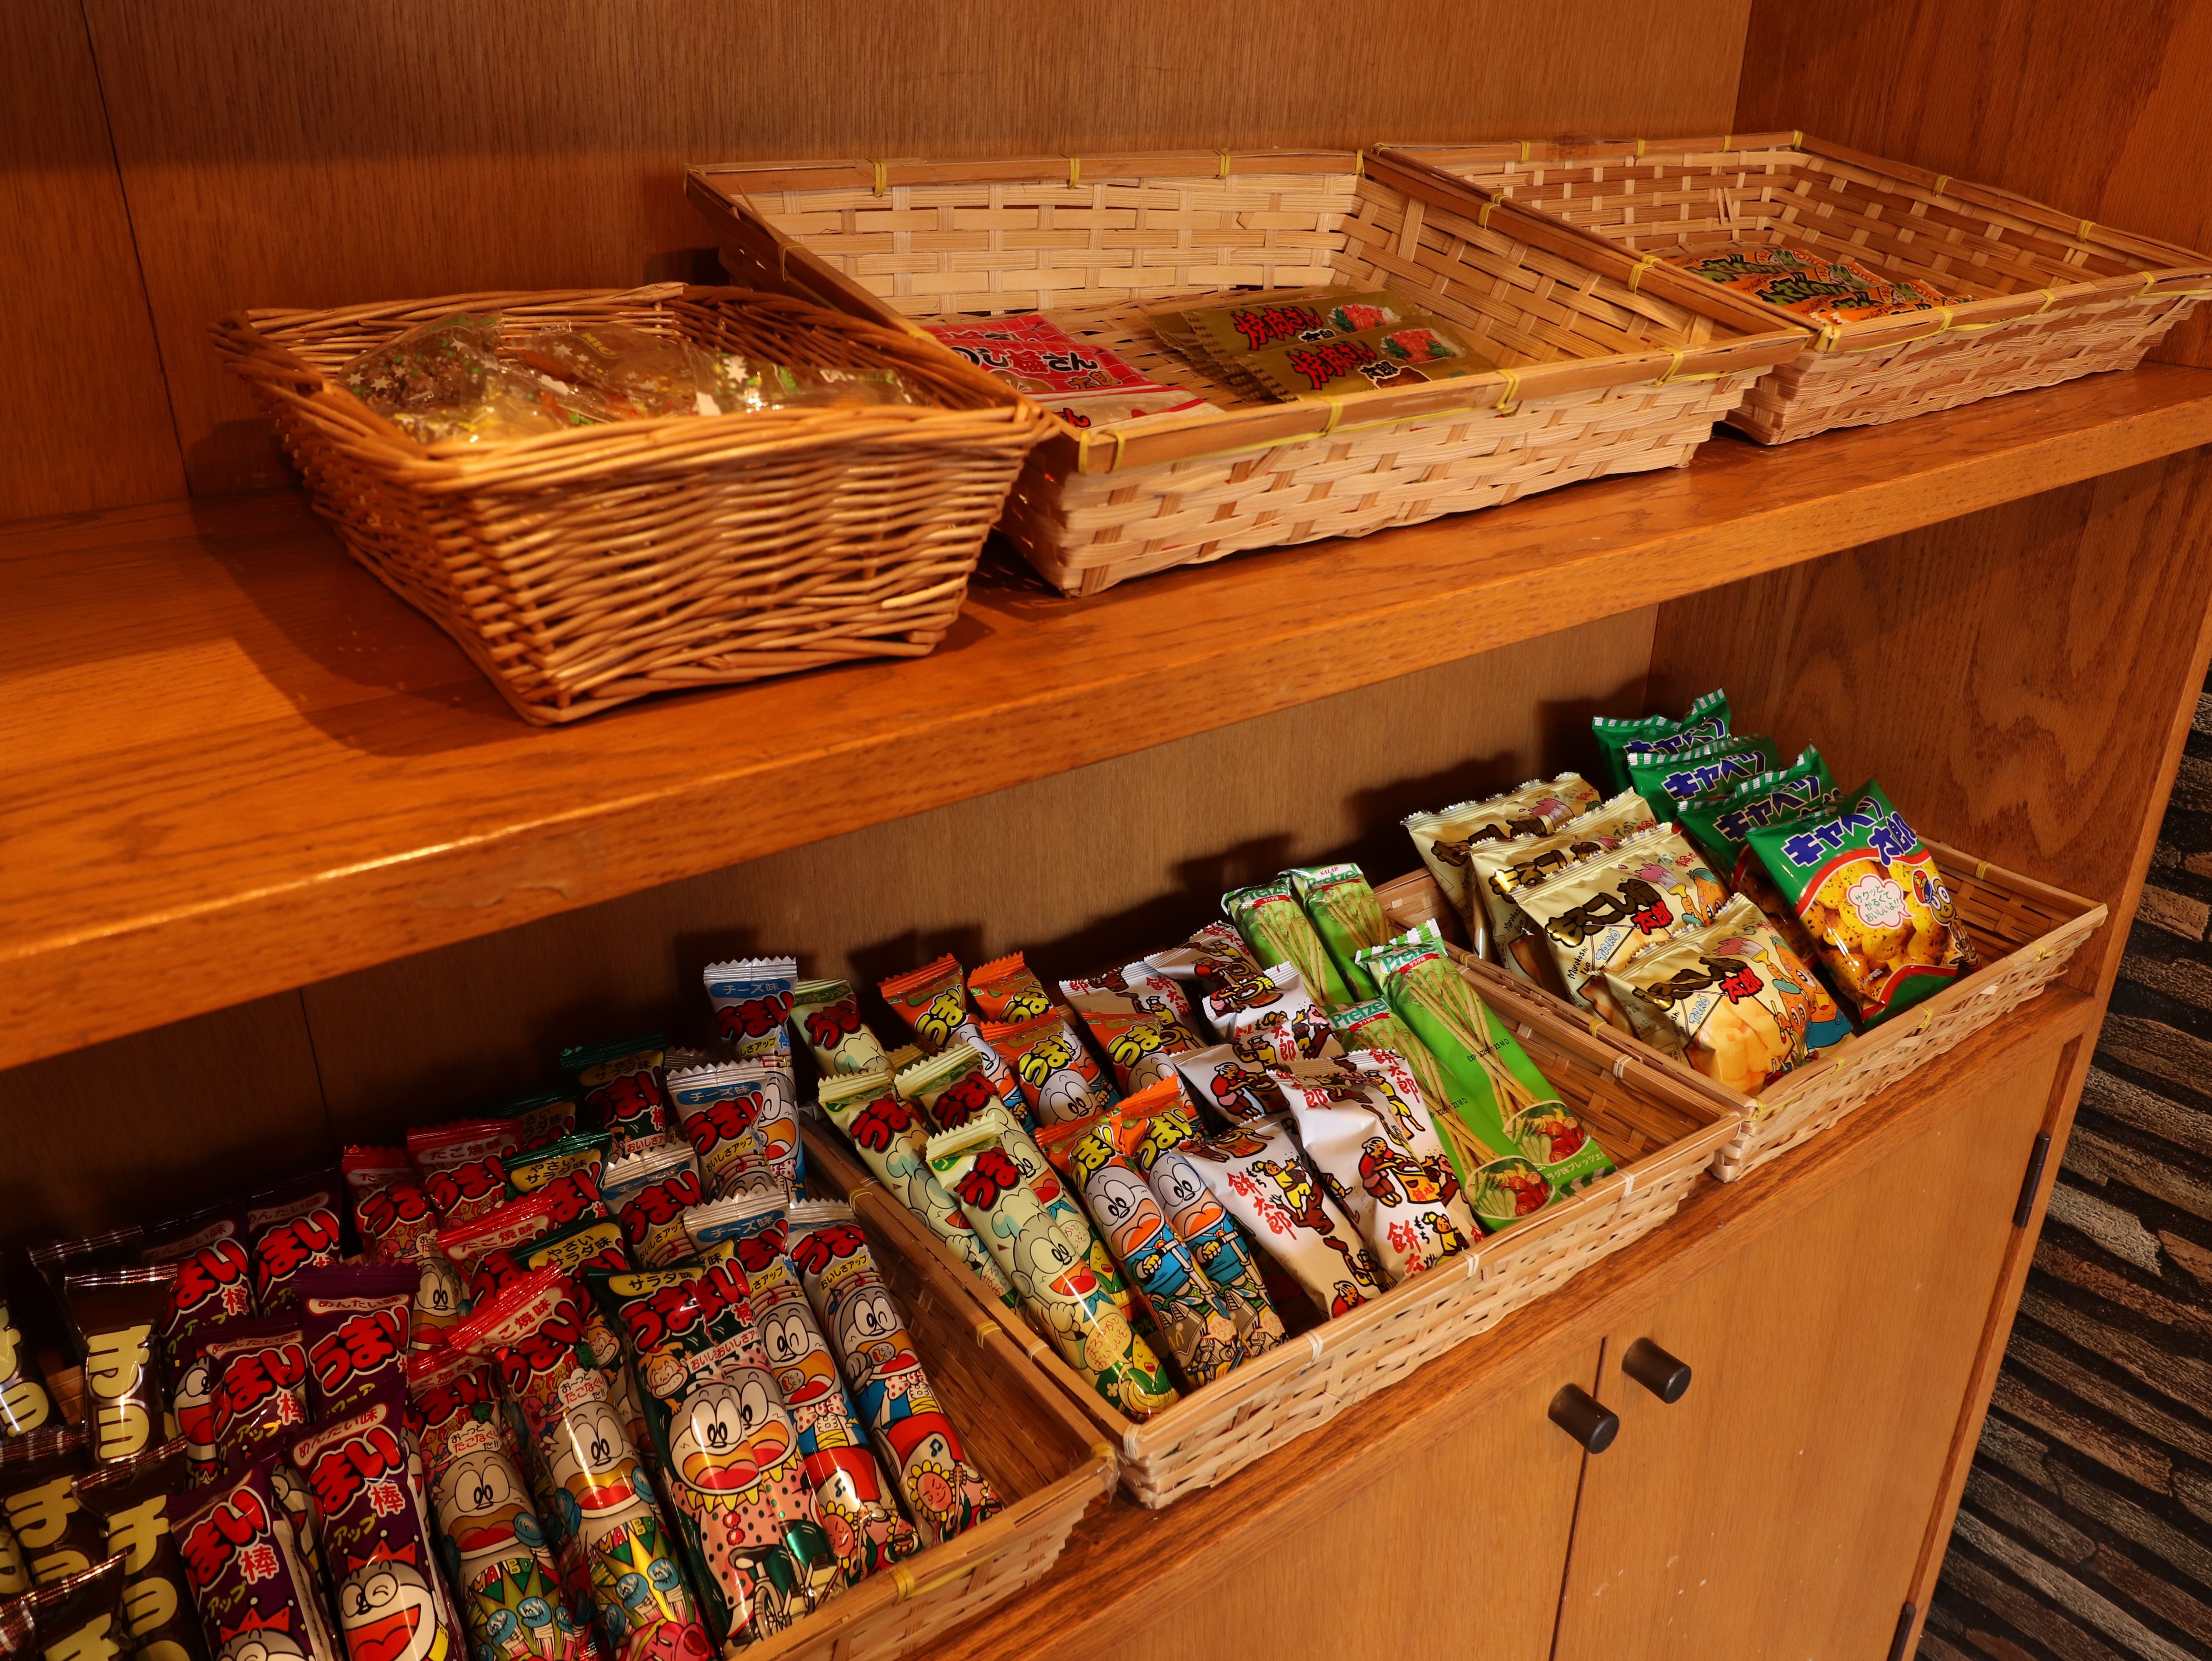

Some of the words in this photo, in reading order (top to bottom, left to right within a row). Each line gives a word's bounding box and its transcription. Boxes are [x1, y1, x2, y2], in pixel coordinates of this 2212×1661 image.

[1288, 340, 1378, 390] 焼肉さん
[1661, 750, 1766, 800] キャベツ
[1781, 796, 1885, 867] キャベツ
[1320, 866, 1338, 876] SALAD
[1238, 883, 1289, 902] Pretze
[1855, 885, 1884, 903] サクッと
[1865, 892, 1892, 911] かるくて
[1631, 901, 1673, 935] 太郎
[1382, 946, 1437, 972] Pretze
[1409, 956, 1426, 967] サラダ味
[723, 982, 780, 995] チーズ味
[1146, 975, 1192, 1017] 餅太郎
[1719, 968, 1764, 1004] 太郎
[716, 992, 794, 1043] うまい
[1358, 1016, 1375, 1025] サラダ味
[595, 1060, 651, 1080] サラダ味
[600, 1056, 640, 1070] やさい
[1369, 1049, 1421, 1103] 餅太郎
[690, 1083, 751, 1102] チーズ味
[522, 1114, 562, 1137] ラダ味
[683, 1091, 763, 1156] うまい
[431, 1138, 502, 1159] たこ焼味
[627, 1134, 664, 1153] おいしさア
[706, 1137, 753, 1173] おいしさアップ
[526, 1159, 587, 1184] サラダ味
[530, 1157, 575, 1172] やさい
[1246, 1167, 1267, 1188] もち
[1546, 1151, 1606, 1180] ラダ味プレッツェル
[551, 1161, 601, 1217] まい
[358, 1183, 426, 1237] うま
[620, 1170, 702, 1245] うまい
[1227, 1171, 1297, 1240] 餅太郎
[460, 1222, 535, 1253] たこ焼味
[712, 1212, 773, 1238] チーズ味
[1414, 1216, 1430, 1244] もち
[144, 1222, 227, 1260] めんたい味
[547, 1235, 594, 1257] やさい
[1387, 1220, 1425, 1277] 餅太
[629, 1271, 694, 1291] サラダ味
[820, 1255, 867, 1290] おいしさアップ
[319, 1296, 401, 1309] めんたい味
[621, 1279, 702, 1350] うま
[212, 1332, 299, 1354] めんたい味
[311, 1306, 408, 1396] うまい
[495, 1301, 587, 1393] うまい
[1086, 1316, 1120, 1360] まろやかで
[1095, 1326, 1128, 1370] おいしいぞ
[418, 1359, 474, 1389] こ焼味
[564, 1379, 606, 1404] たこなぐい
[298, 1408, 378, 1458] めんたい味
[373, 1485, 404, 1515] 棒
[241, 1546, 277, 1581] 棒
